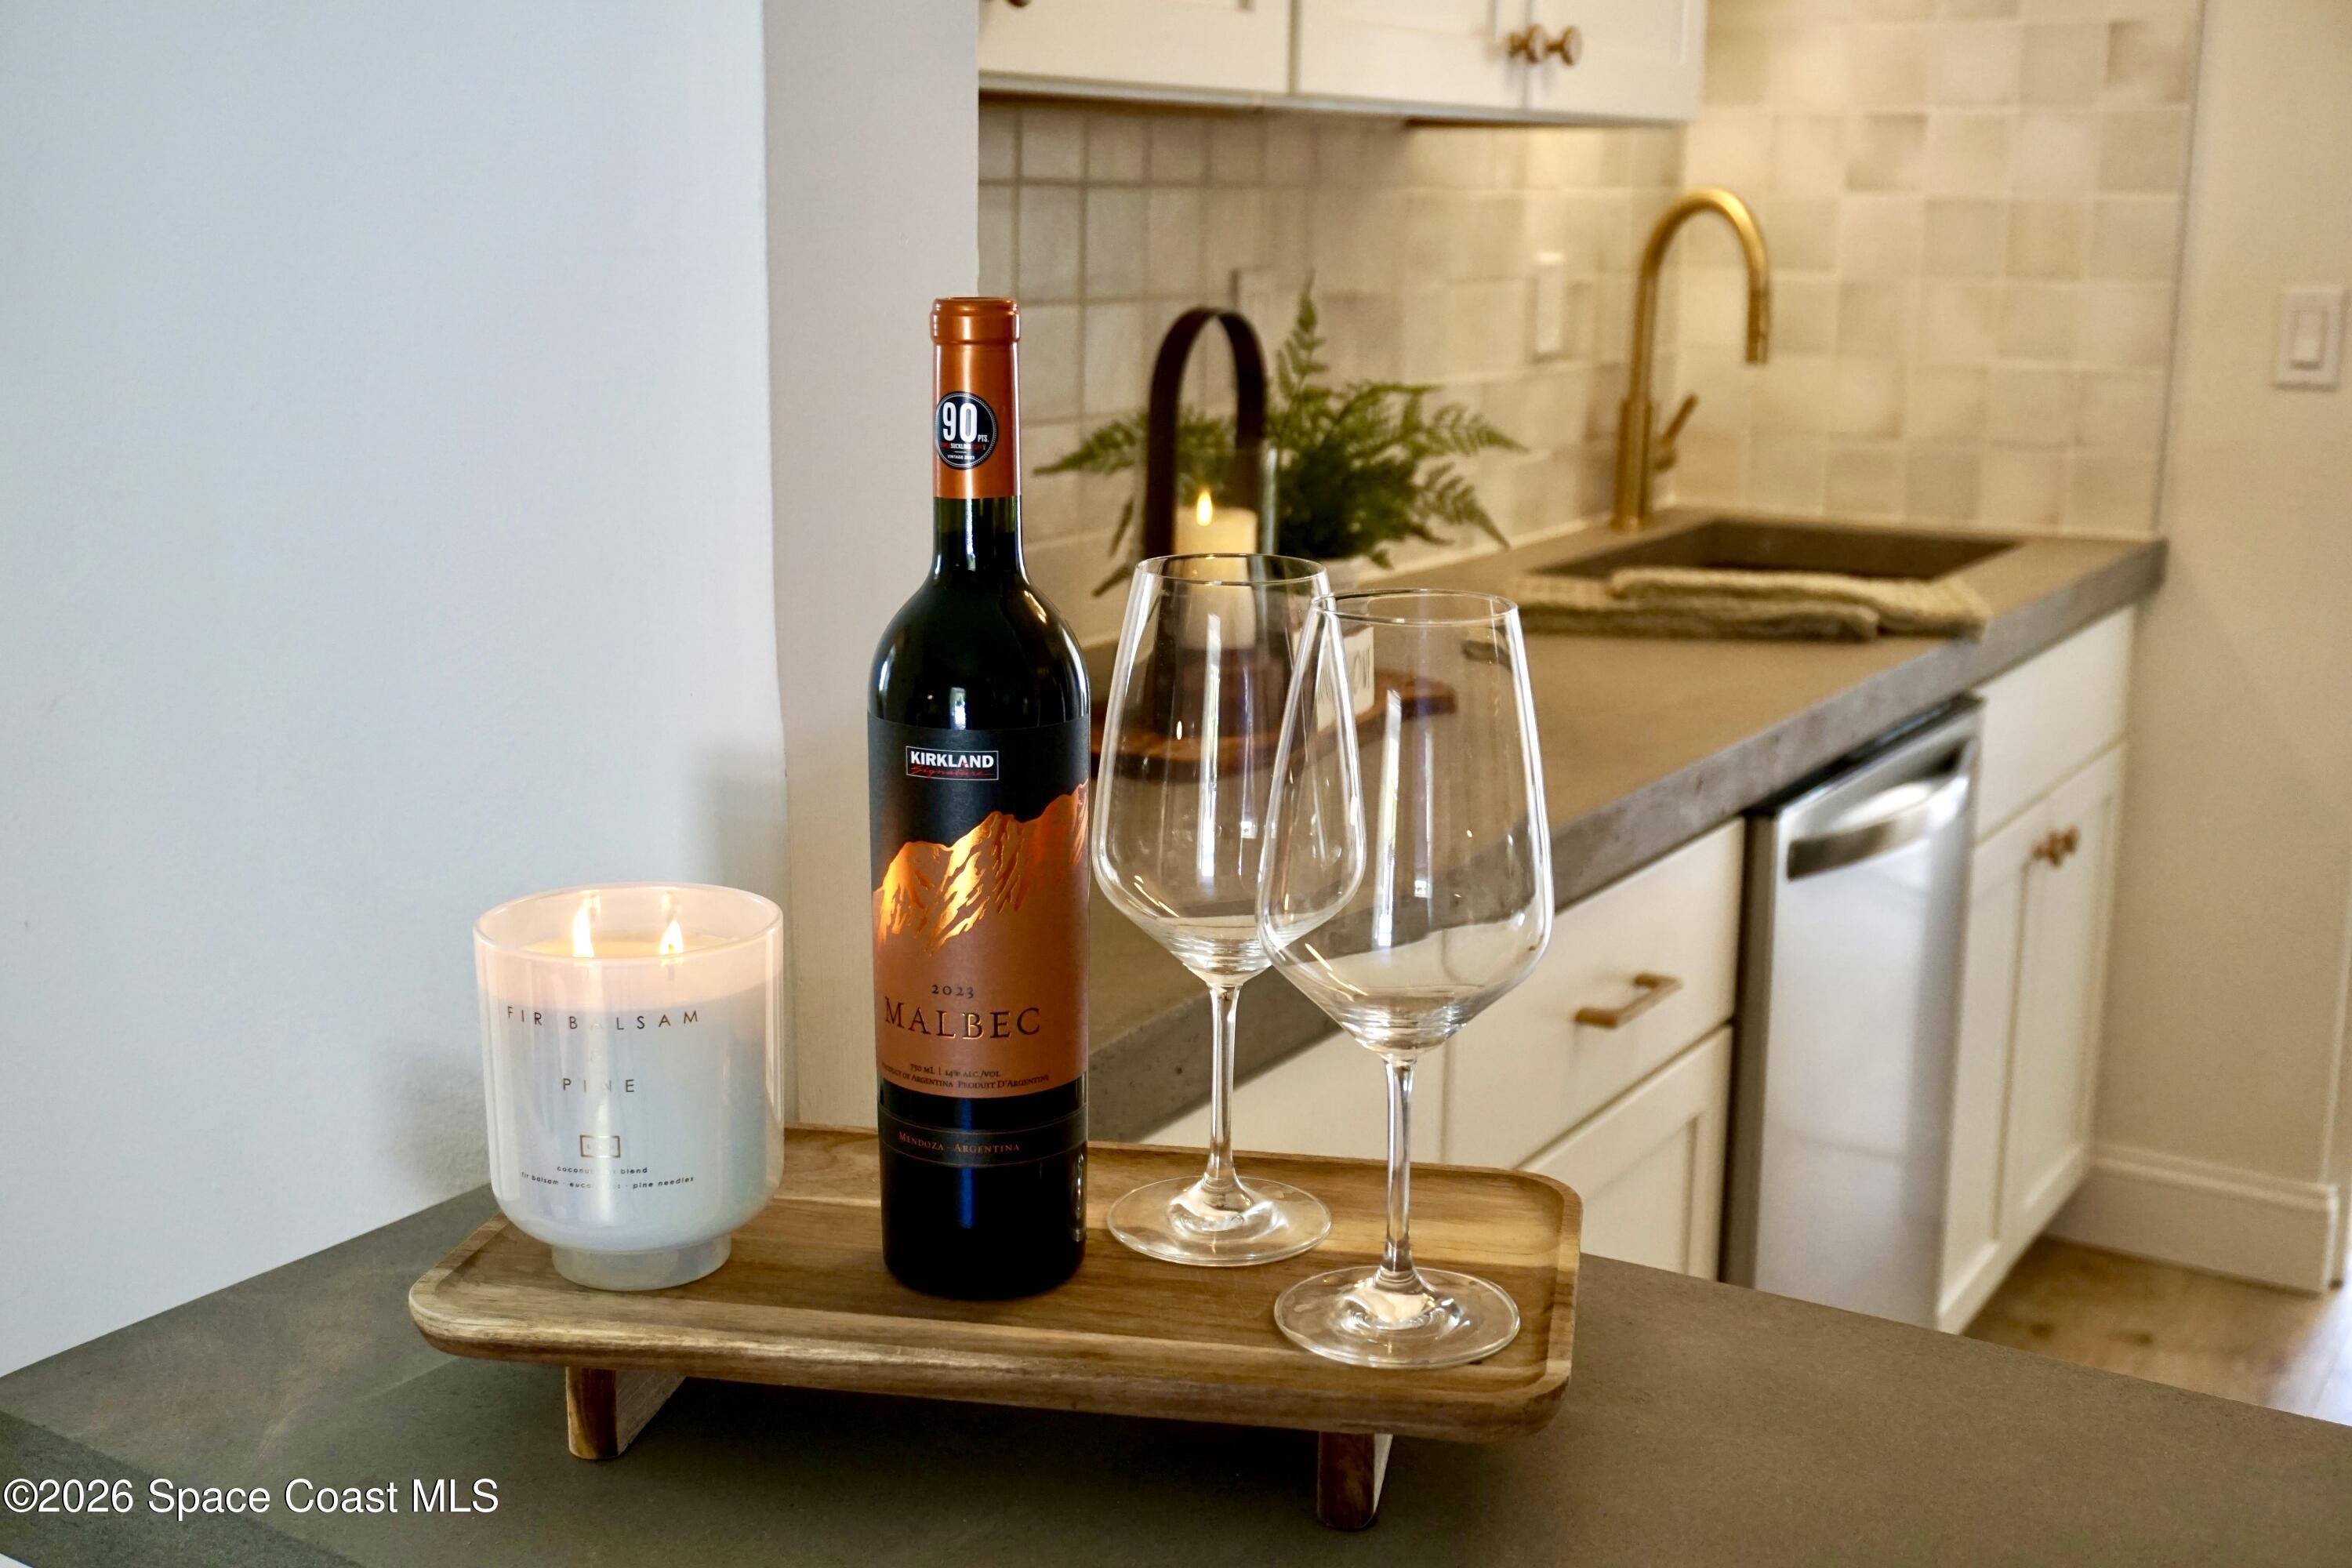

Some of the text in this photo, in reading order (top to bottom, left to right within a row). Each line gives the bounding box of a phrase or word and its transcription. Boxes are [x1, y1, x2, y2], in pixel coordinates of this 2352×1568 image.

[942, 401, 989, 443] 90 PTS.
[910, 750, 994, 768] KIRKLAND
[909, 765, 994, 779] Signature
[931, 984, 975, 999] 2023
[507, 1006, 543, 1026] FIR
[884, 996, 1040, 1040] MALBEC
[909, 1063, 921, 1073] 750
[562, 1078, 634, 1093] PINE
[911, 1073, 953, 1087] ARGENTINA
[898, 1131, 1020, 1154] MENDOZA ARGENTINA
[557, 1166, 593, 1174] coconu
[532, 1175, 559, 1185] balsam
[658, 1176, 694, 1186] needles
